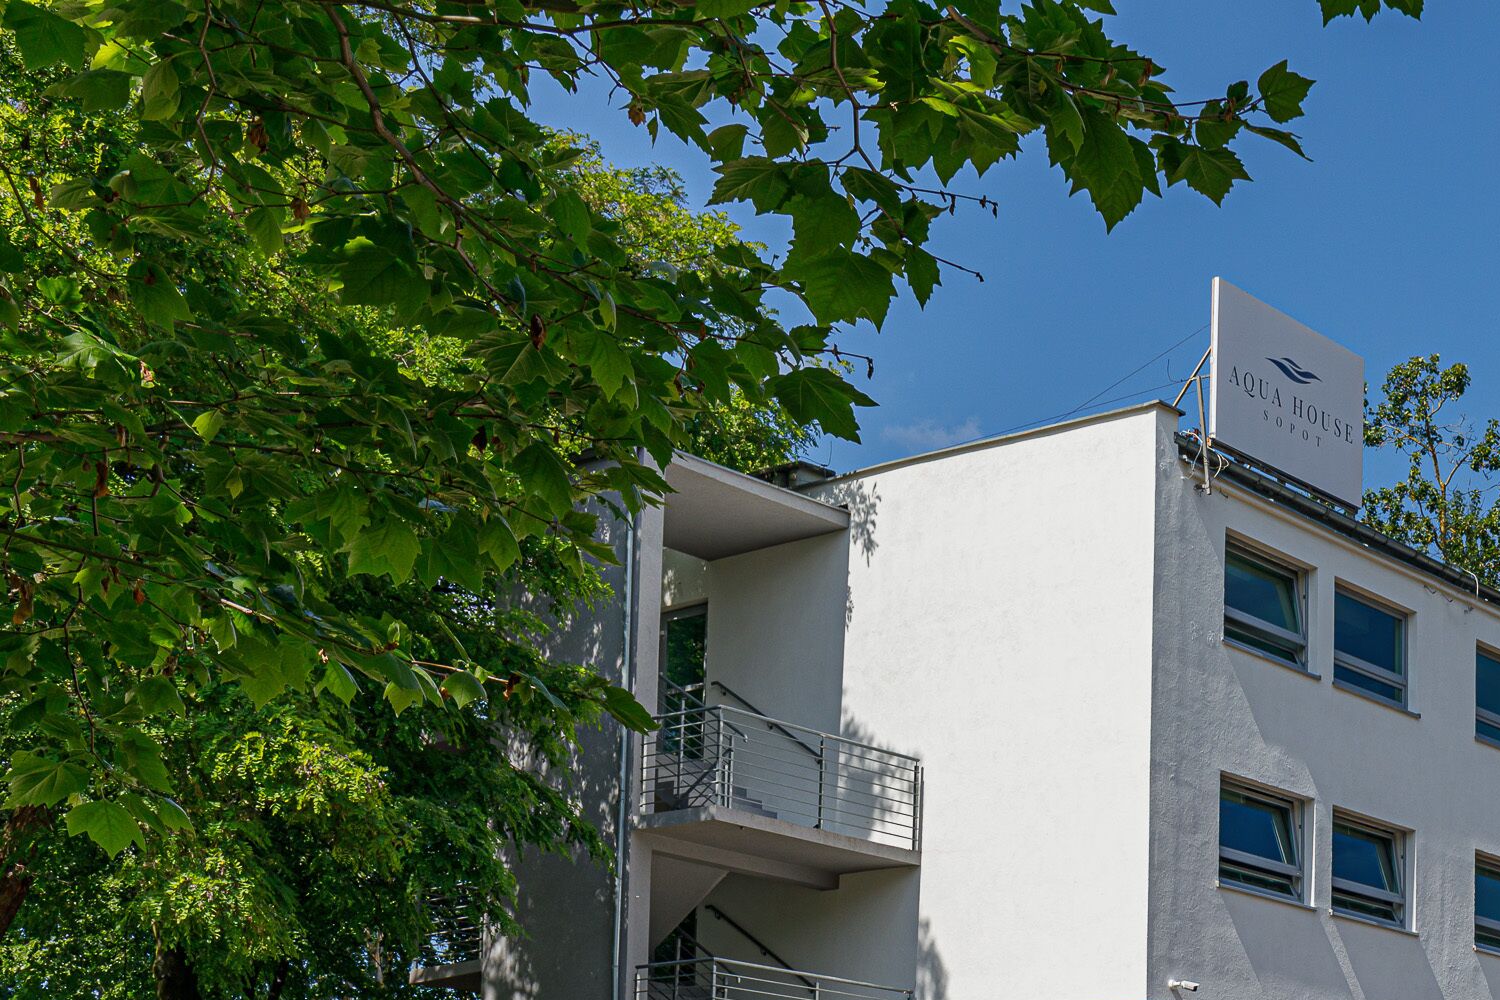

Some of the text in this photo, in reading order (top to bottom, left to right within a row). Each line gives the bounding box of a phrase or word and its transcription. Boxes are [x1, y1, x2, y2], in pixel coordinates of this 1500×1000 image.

[1229, 365, 1354, 445] AQUA HOUSE
[1263, 410, 1322, 447] SOPOT
